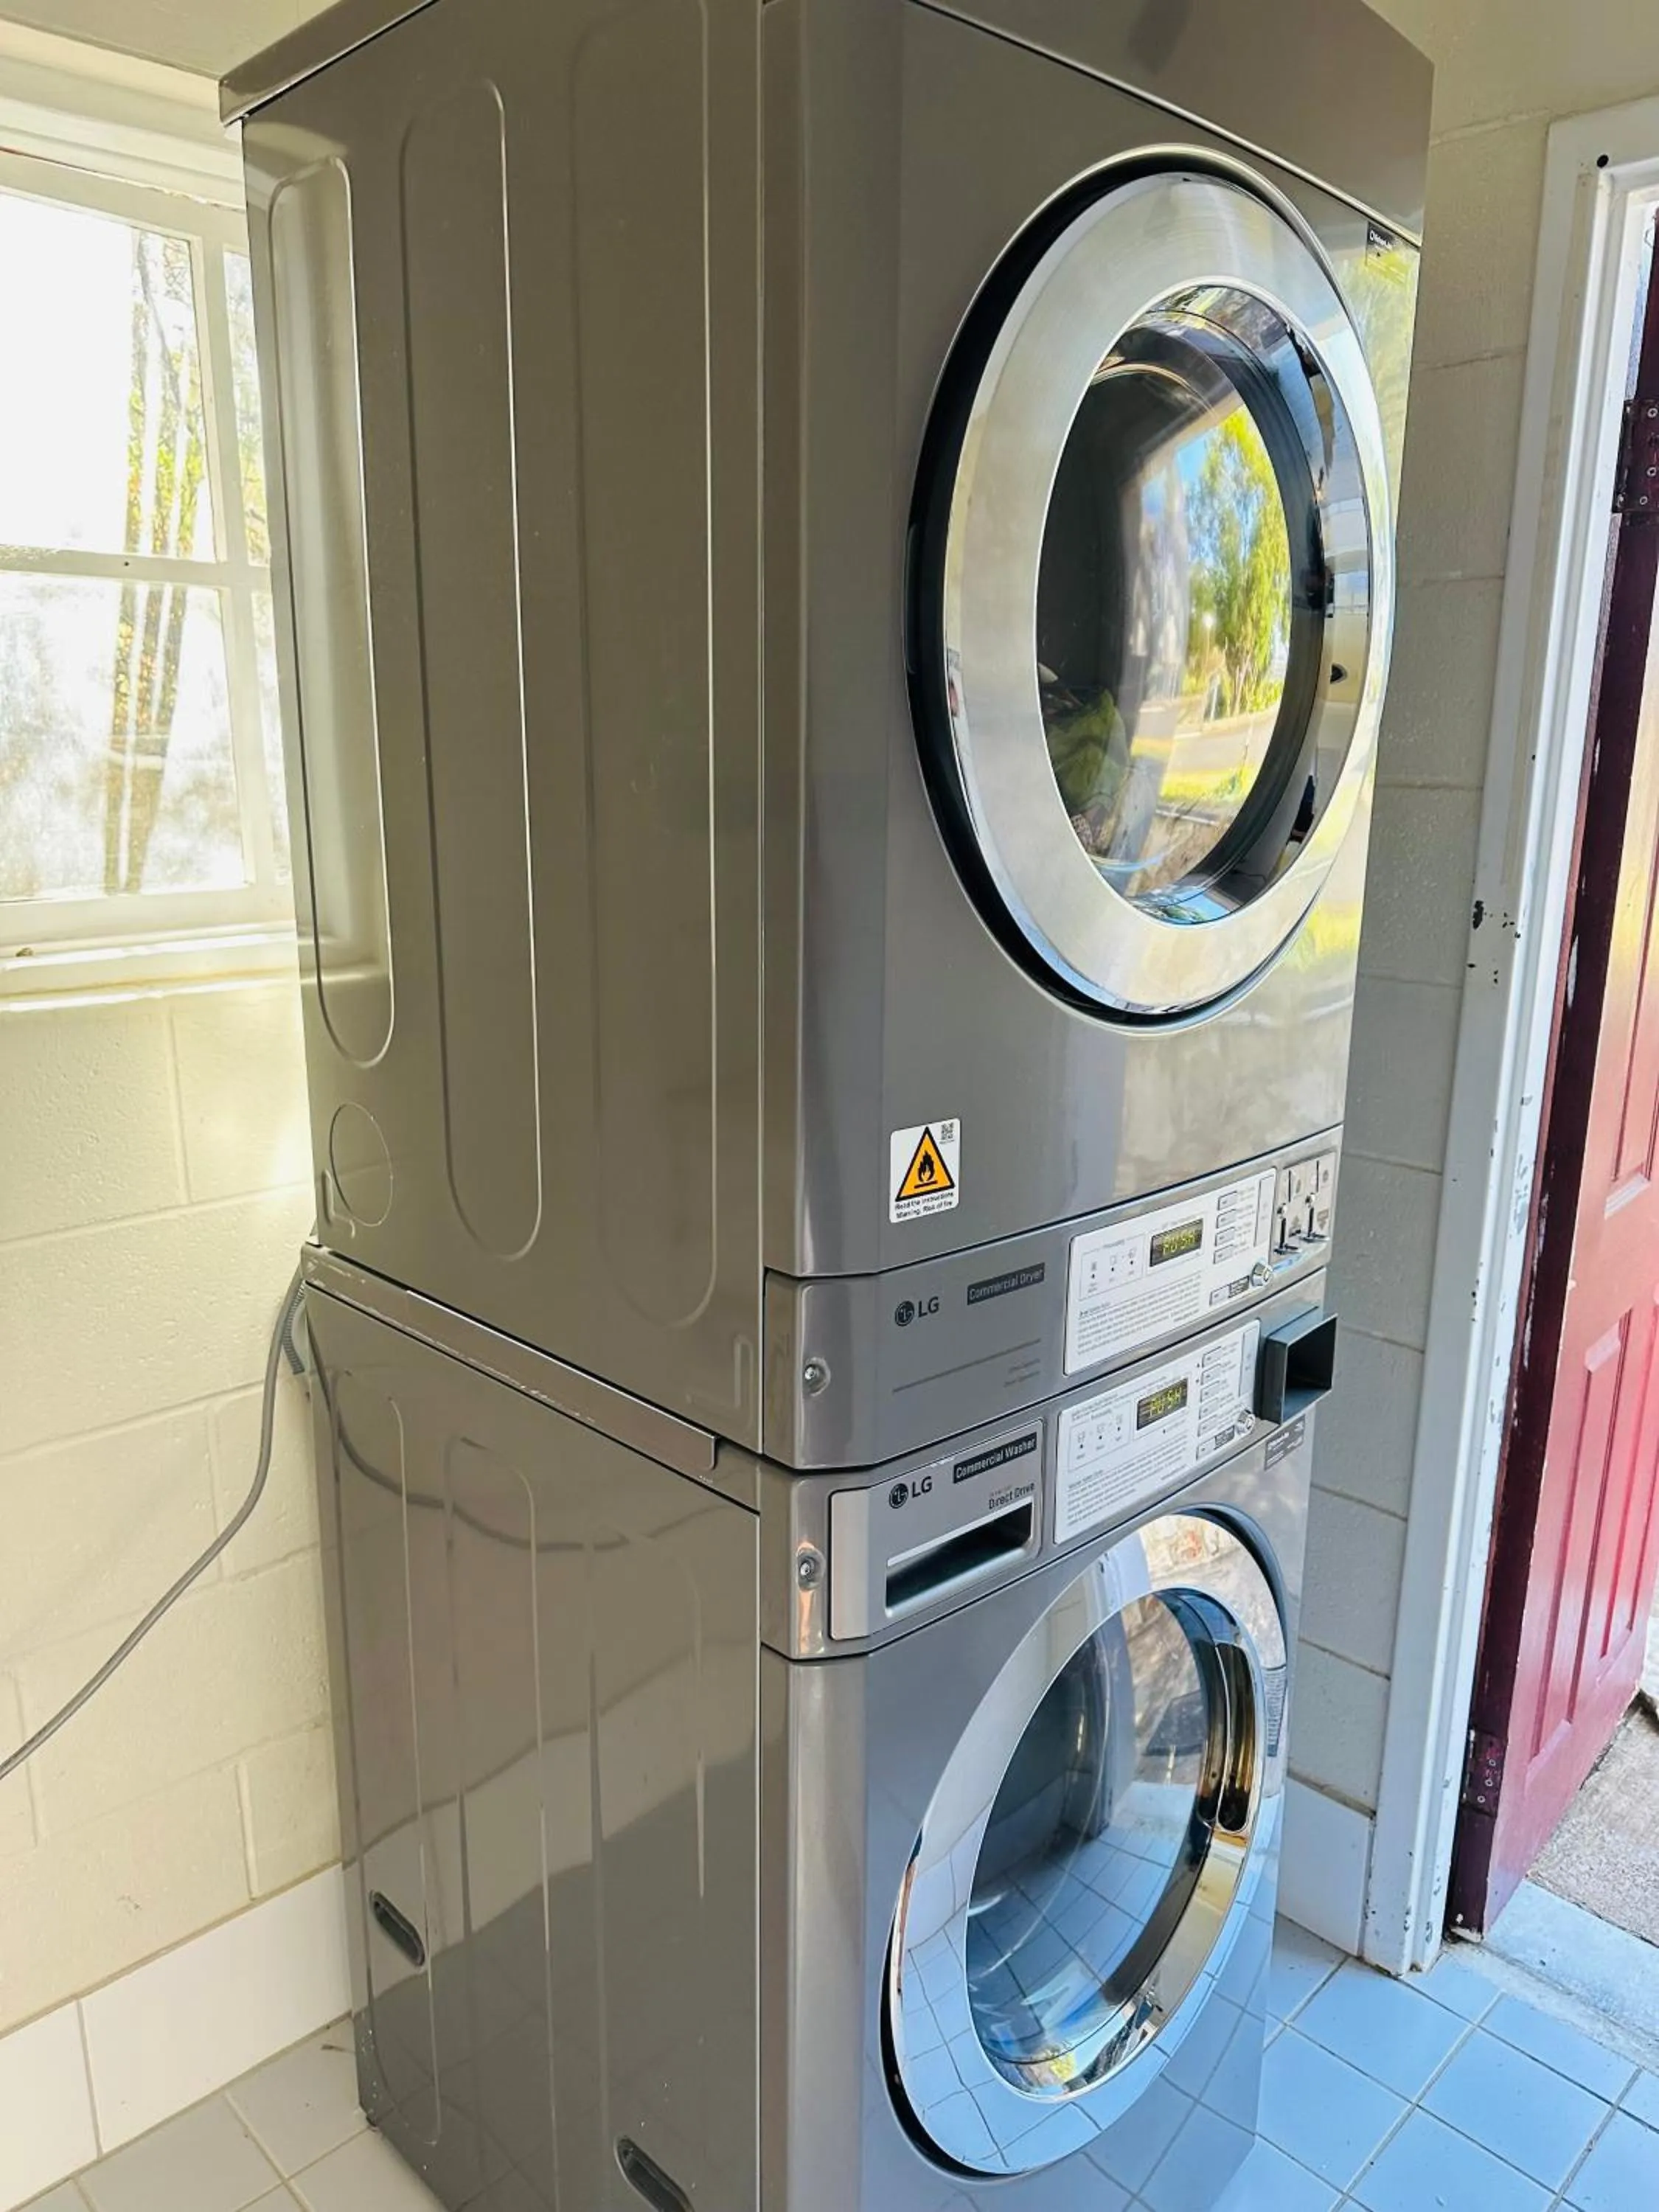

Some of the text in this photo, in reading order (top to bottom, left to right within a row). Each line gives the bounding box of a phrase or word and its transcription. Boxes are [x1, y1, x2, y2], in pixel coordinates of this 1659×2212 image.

[970, 1274, 1018, 1300] Commercial
[918, 1296, 939, 1318] LG
[956, 1439, 1035, 1478] Commercial Washer
[912, 1475, 933, 1498] LG
